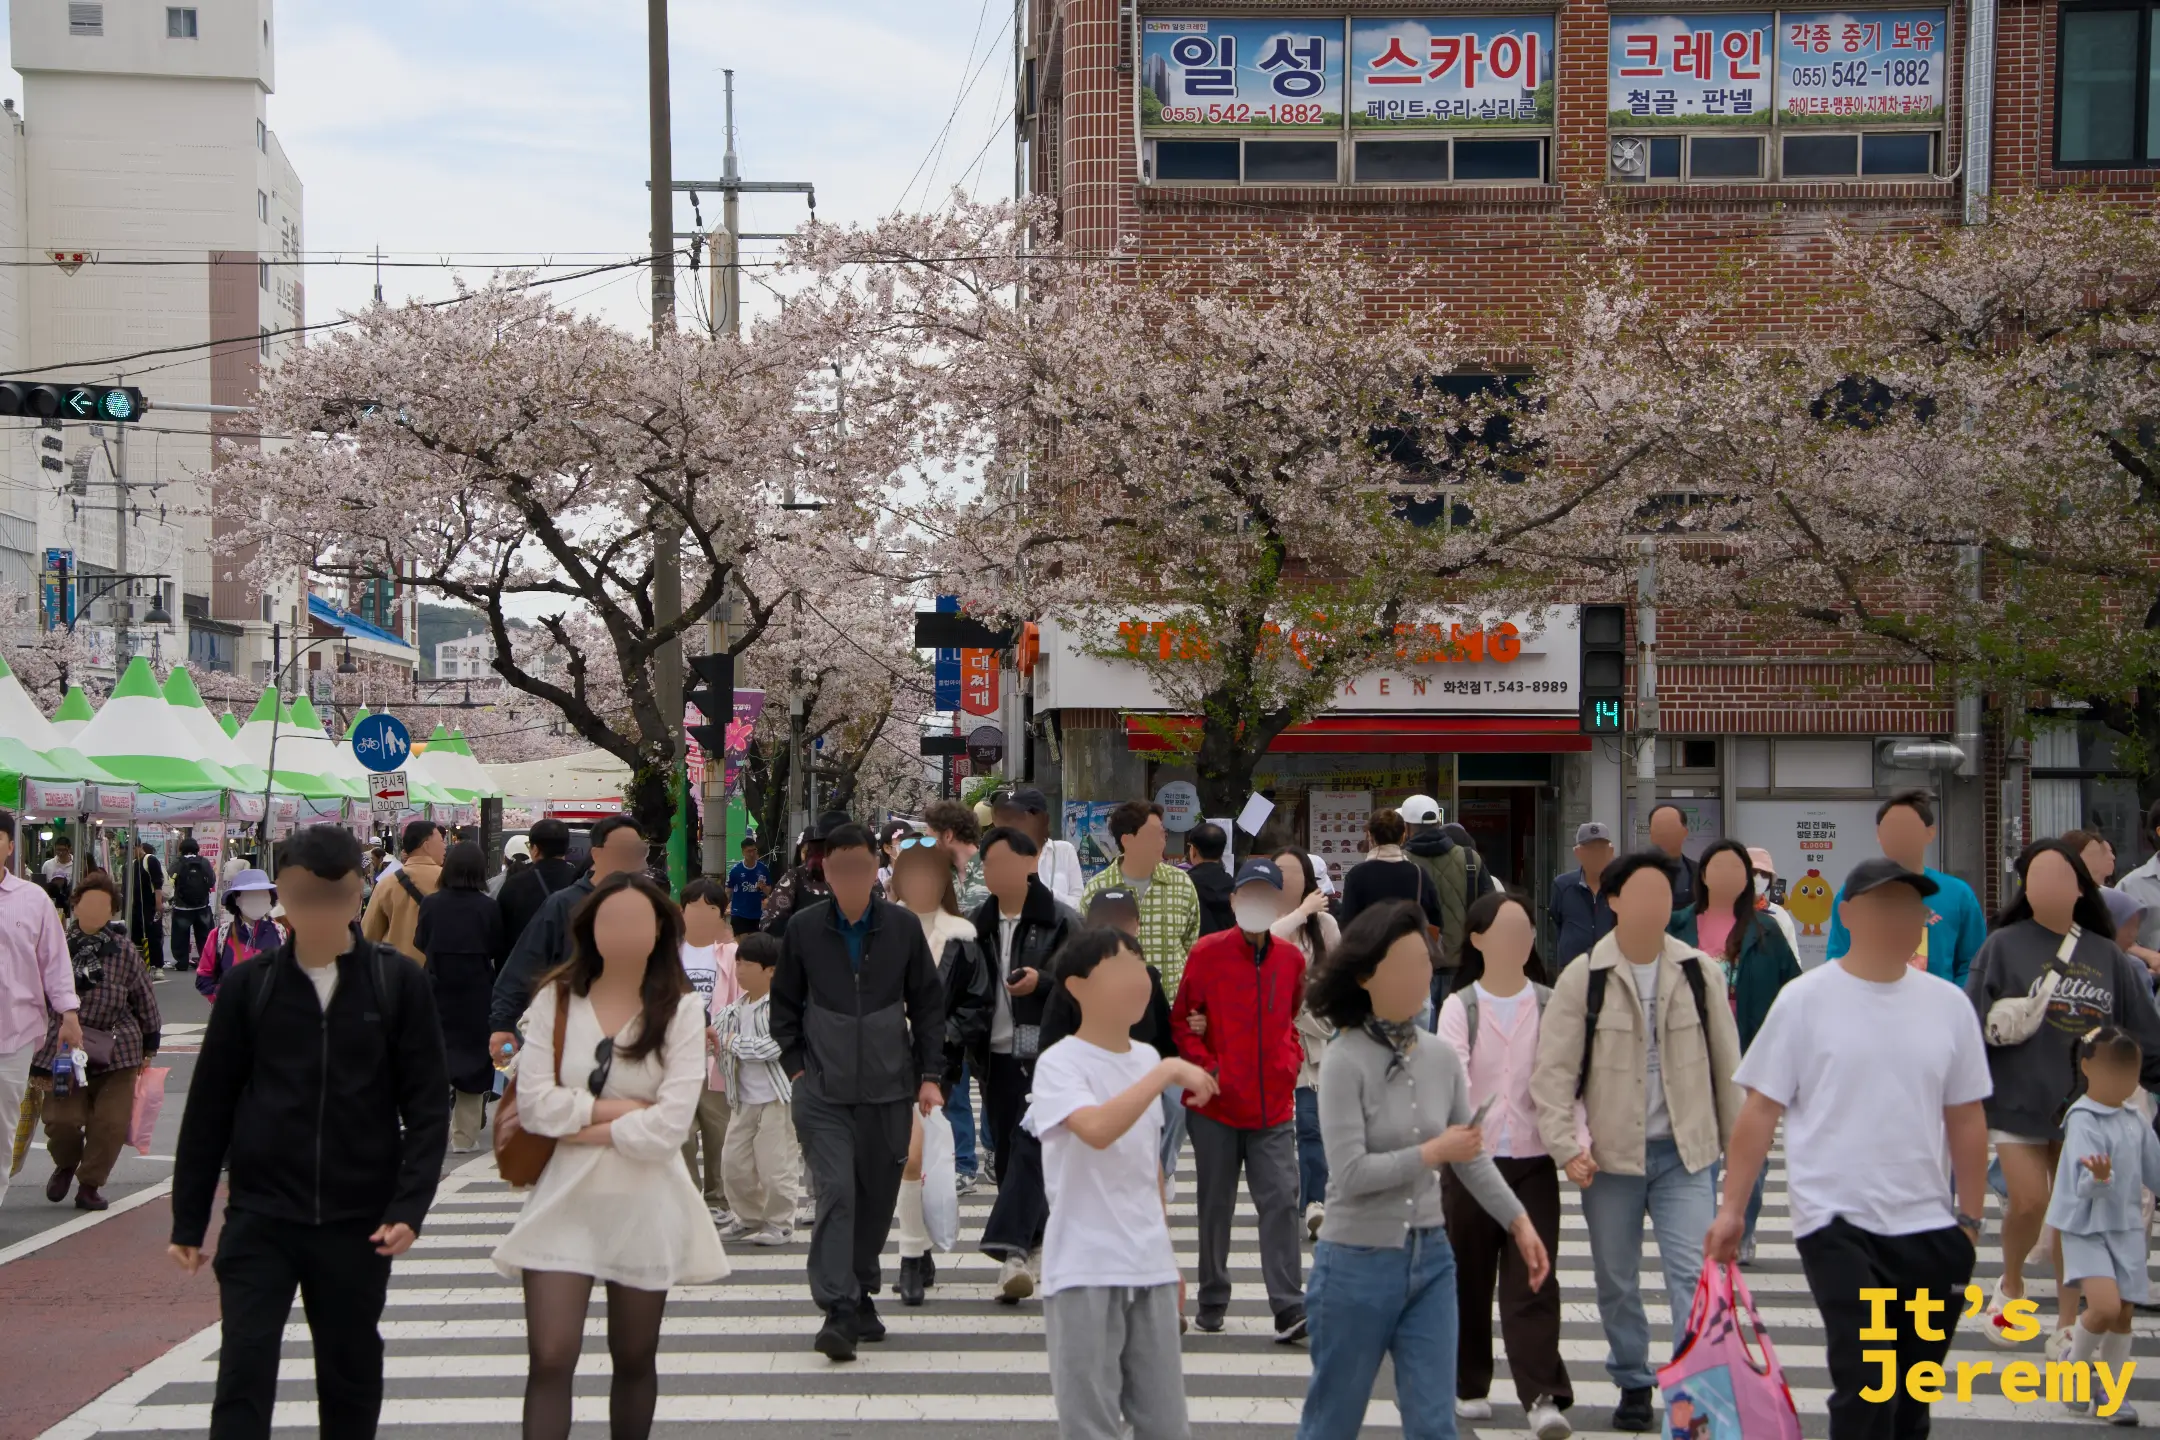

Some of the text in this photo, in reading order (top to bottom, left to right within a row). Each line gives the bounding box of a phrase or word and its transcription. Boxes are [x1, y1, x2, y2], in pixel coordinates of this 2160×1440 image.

[1790, 21, 1934, 53] 각종 중기 보유
[1368, 34, 1537, 89] 스카이
[1620, 31, 1761, 80] 크레인
[969, 647, 989, 707] 대찌개
[1596, 701, 1618, 727] 14
[372, 775, 405, 789] 구간시작
[377, 801, 404, 810] 300m
[1796, 821, 1836, 829] 치킨 전 메뉴
[1796, 831, 1836, 839] 방문 포장 시
